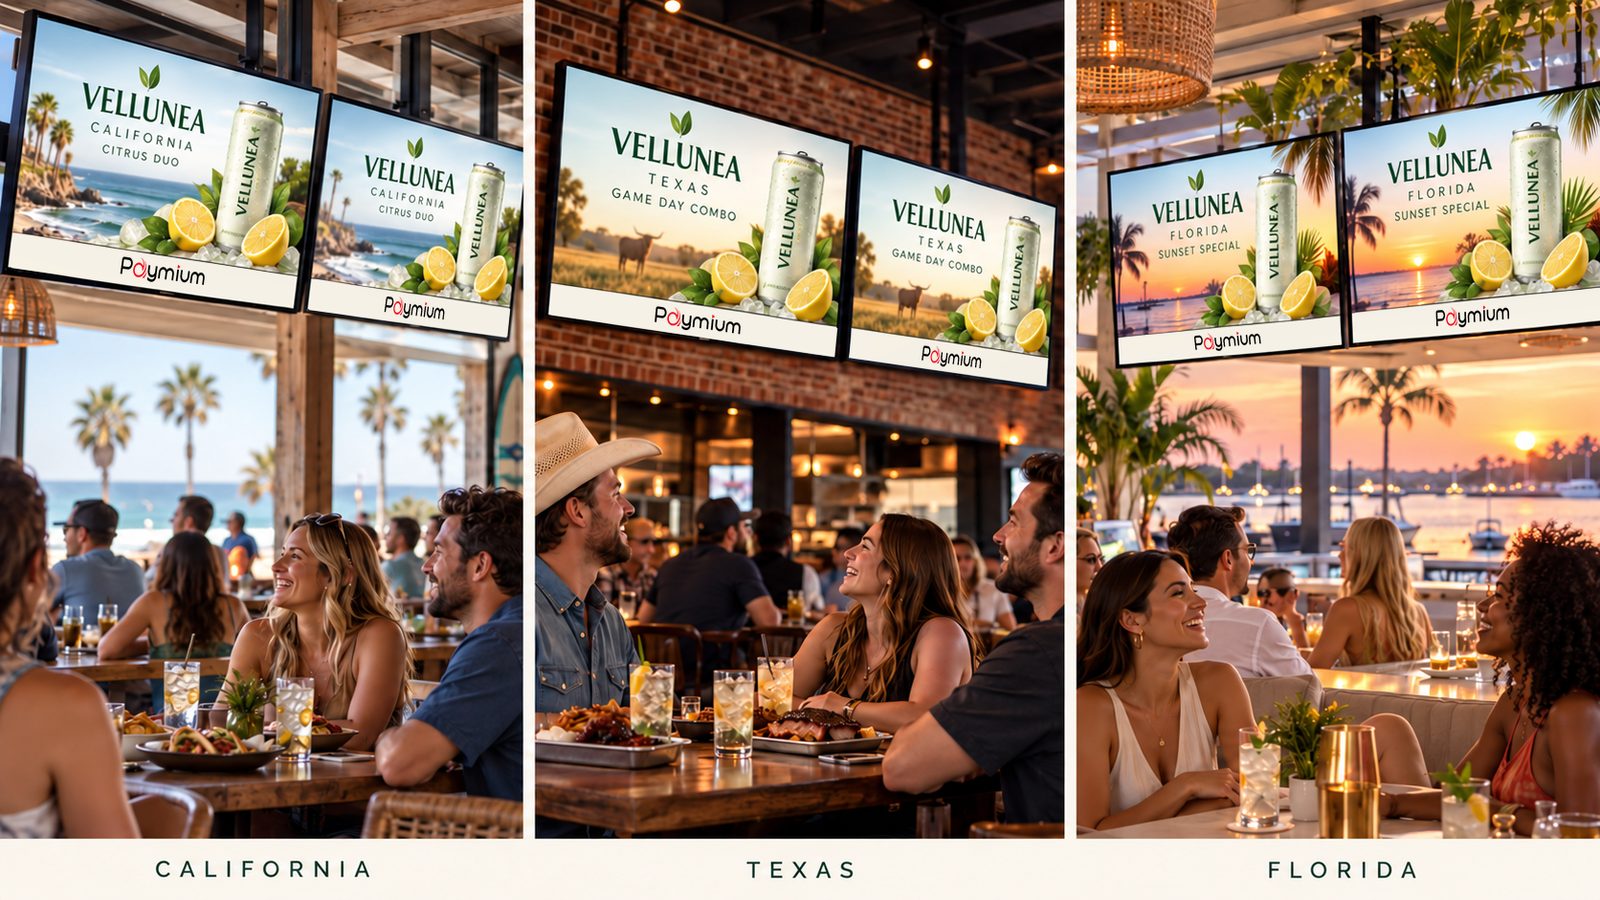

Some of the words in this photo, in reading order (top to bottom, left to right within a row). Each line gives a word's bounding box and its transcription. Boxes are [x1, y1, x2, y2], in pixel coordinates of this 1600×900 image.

[82, 82, 205, 134] VELLUNEA
[90, 122, 194, 152] CALIFORNIA
[102, 143, 149, 162] CITRUS
[153, 153, 180, 167] DUO
[611, 127, 741, 182] VELLUNEA
[1387, 147, 1492, 185] VELLUNEA
[235, 137, 260, 216] VELLUNEA
[364, 155, 455, 195] VELLUNEA
[649, 173, 710, 196] TEXAS
[1408, 182, 1475, 201] FLORIDA
[371, 187, 445, 209] CALIFORNIA
[379, 205, 412, 219] CITRUS
[416, 212, 435, 222] DUO
[611, 188, 652, 204] GAME
[658, 196, 685, 212] DAY
[690, 203, 737, 222] COMBO
[1152, 191, 1243, 224] VELLUNEA
[1394, 207, 1438, 222] SUNSET
[1441, 200, 1490, 217] SPECIAL
[1528, 159, 1540, 244] VELLUNEA
[470, 192, 488, 258] VELLUNEA
[777, 188, 800, 269] VELLUNEA
[892, 199, 986, 242] VELLUNEA
[1170, 224, 1229, 241] FLORIDA
[919, 236, 964, 253] TEXAS
[1158, 246, 1196, 259] SUNSET
[1199, 241, 1240, 255] SPECIAL
[1269, 203, 1279, 279] VELLUNEA
[892, 249, 922, 262] GAME
[926, 255, 945, 268] DAY
[948, 261, 983, 274] COMBO
[1009, 244, 1025, 311] VELLUNEA
